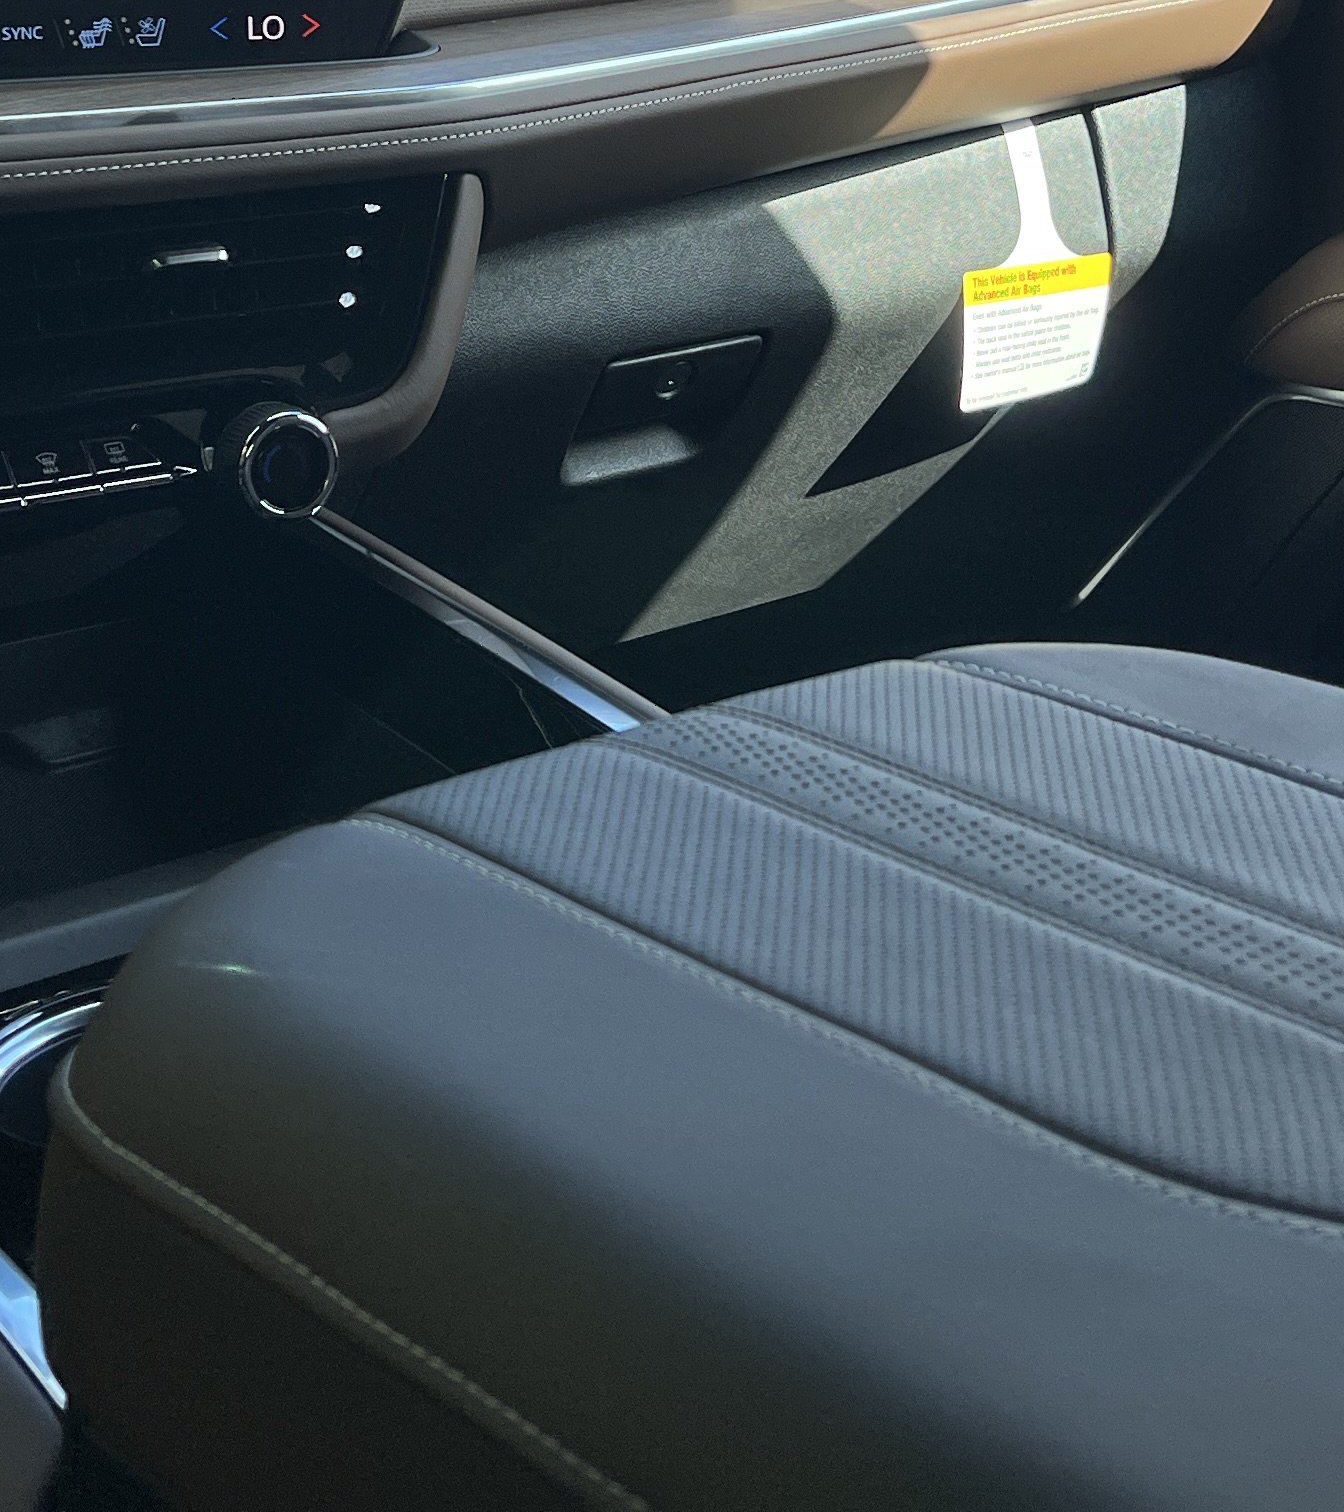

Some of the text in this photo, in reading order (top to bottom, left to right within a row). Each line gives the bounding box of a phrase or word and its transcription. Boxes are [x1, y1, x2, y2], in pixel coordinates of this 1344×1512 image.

[1, 25, 44, 41] SYNC
[247, 14, 285, 41] LO
[972, 264, 1077, 288] This Vehicle is Equipped with
[972, 284, 1041, 302] Advanced Air Bags
